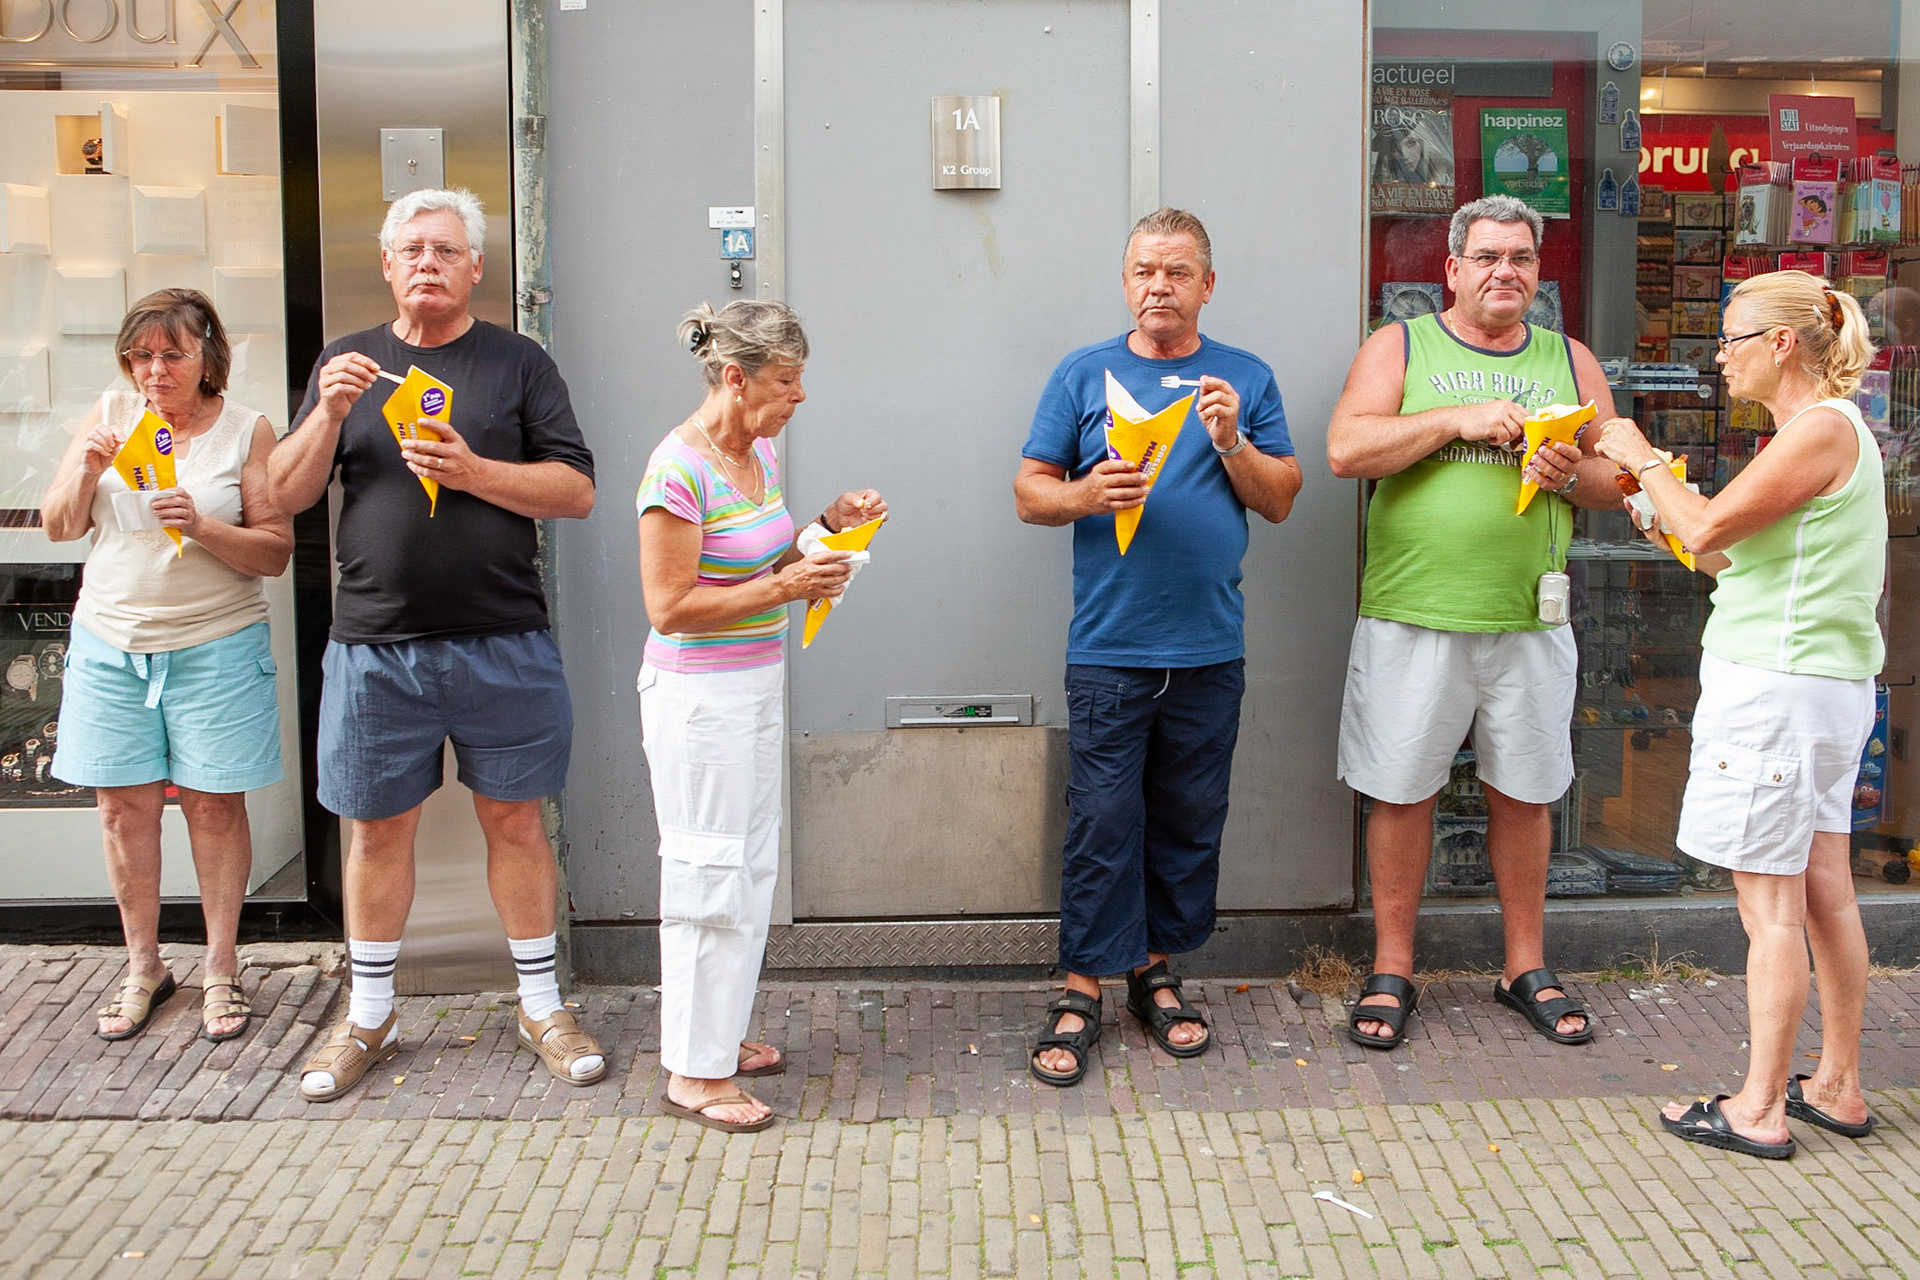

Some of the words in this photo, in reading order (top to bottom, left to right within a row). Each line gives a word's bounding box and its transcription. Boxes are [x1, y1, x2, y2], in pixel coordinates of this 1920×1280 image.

[1372, 64, 1455, 84] actueel
[952, 108, 981, 131] 1A
[1484, 113, 1563, 130] happinez
[1782, 120, 1798, 130] STAT
[942, 164, 957, 176] K2
[960, 164, 992, 178] Group
[1372, 187, 1385, 199] LA
[1387, 187, 1405, 199] VIE
[1408, 188, 1422, 199] EN
[1425, 189, 1454, 200] ROSE
[724, 233, 750, 252] 1A
[1429, 370, 1486, 395] HIGH
[17, 612, 72, 631] VEND
